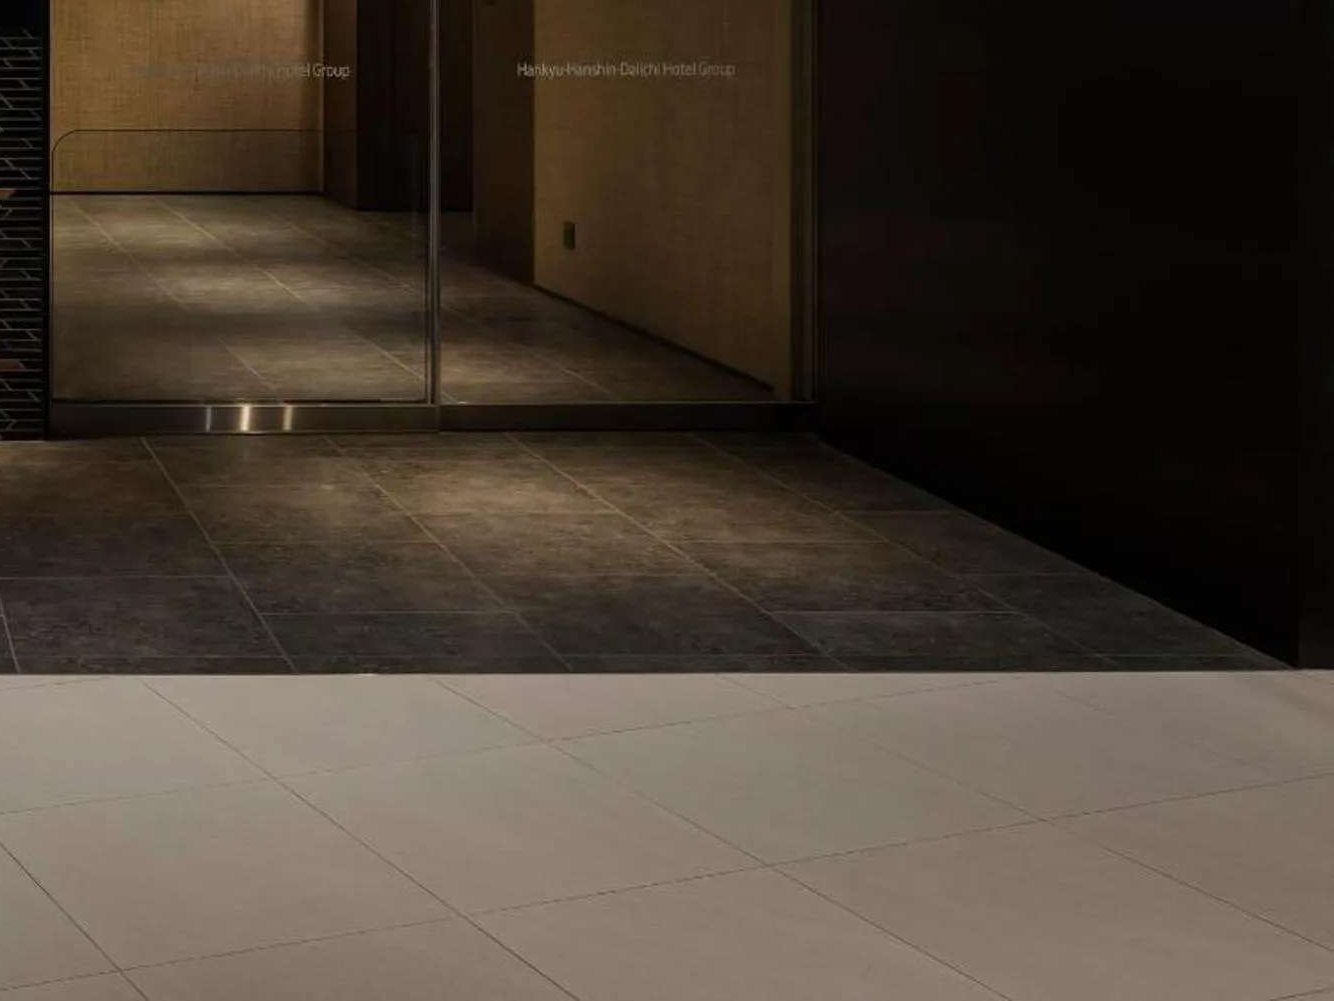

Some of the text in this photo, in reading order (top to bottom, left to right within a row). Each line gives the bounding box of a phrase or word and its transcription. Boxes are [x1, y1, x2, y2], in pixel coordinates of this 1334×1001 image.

[312, 63, 351, 80] Group
[662, 62, 697, 76] Hotel
[698, 61, 736, 79] Group
